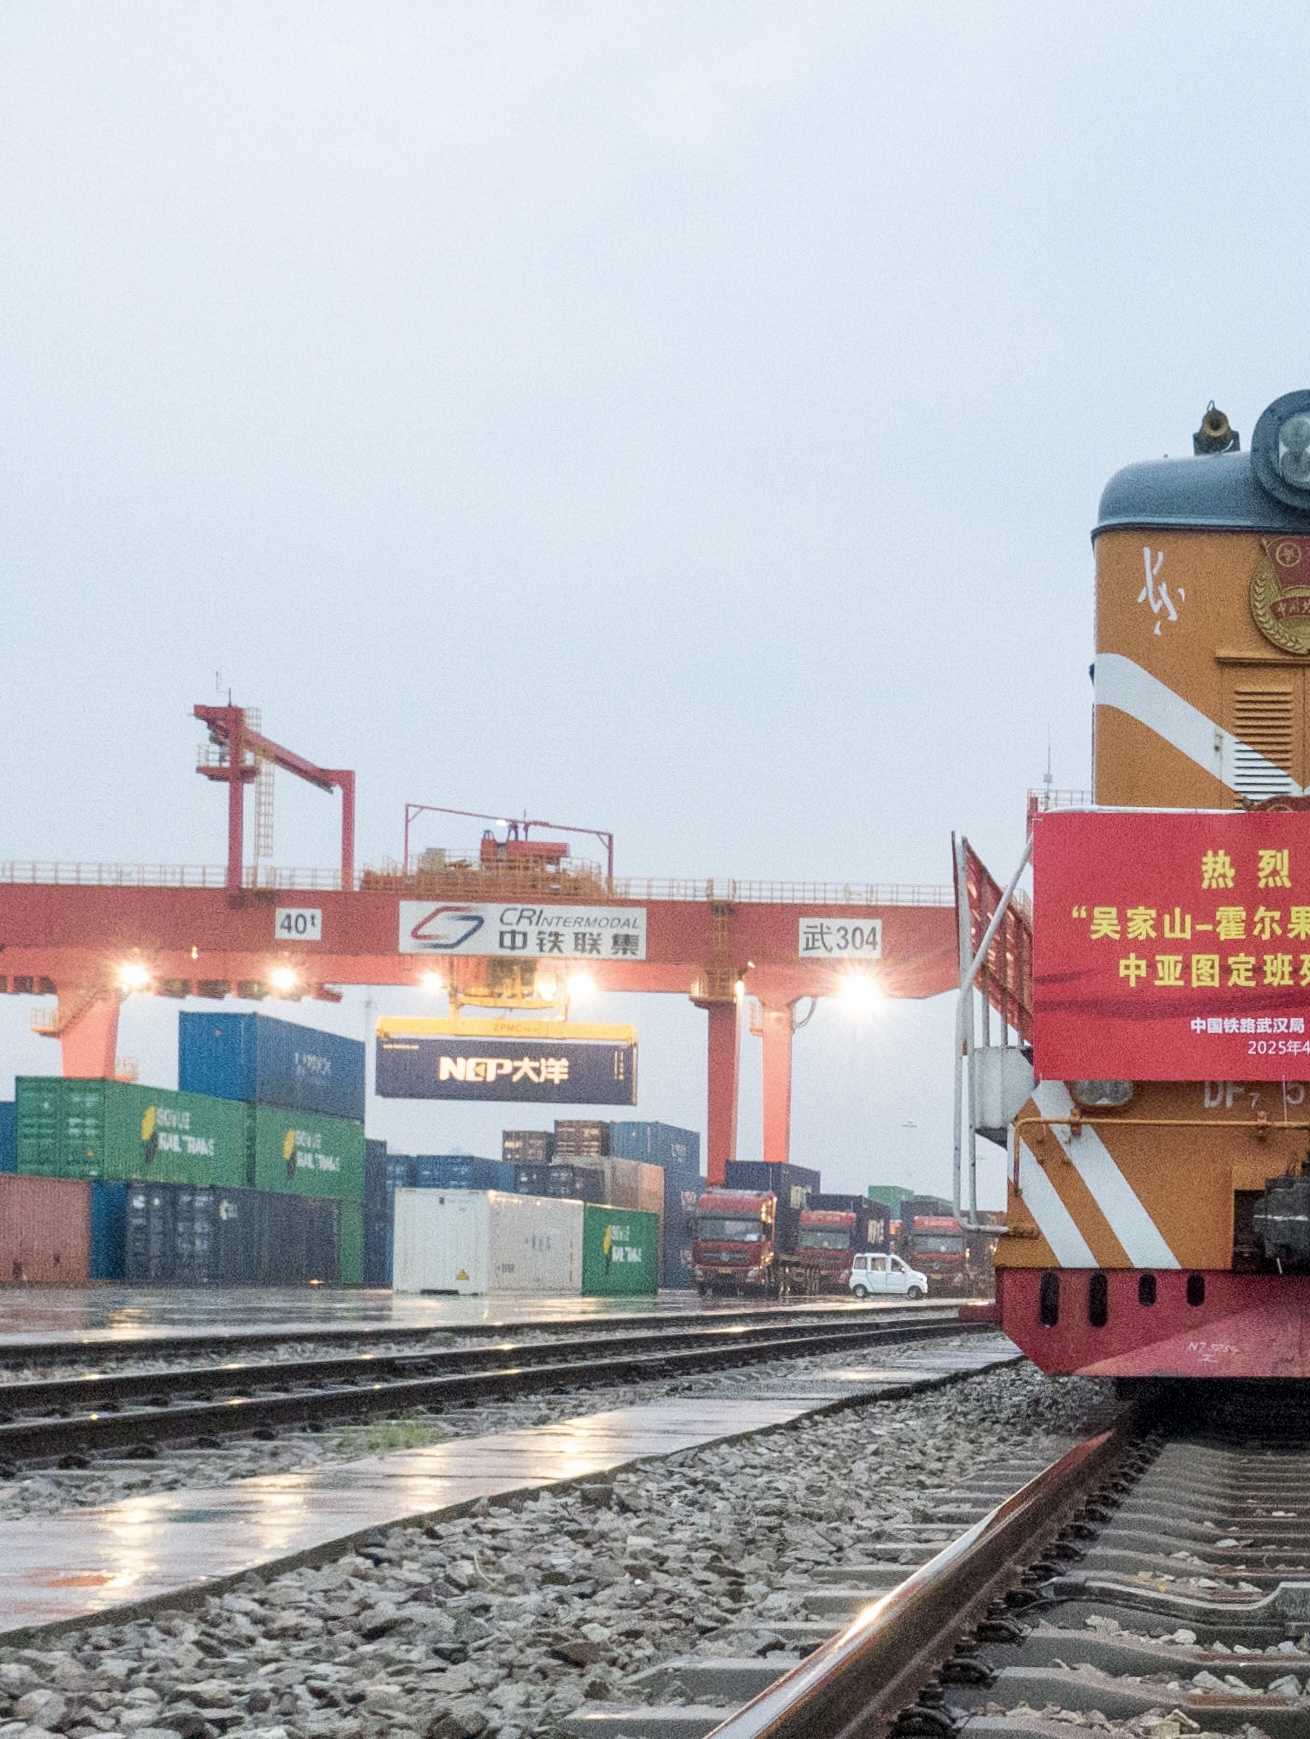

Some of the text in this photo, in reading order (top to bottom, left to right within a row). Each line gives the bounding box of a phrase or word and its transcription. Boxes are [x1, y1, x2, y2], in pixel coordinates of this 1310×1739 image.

[498, 929, 640, 956] 中铁联集
[803, 922, 879, 953] 武304
[1191, 1017, 1305, 1034] 中国铁路武汉局
